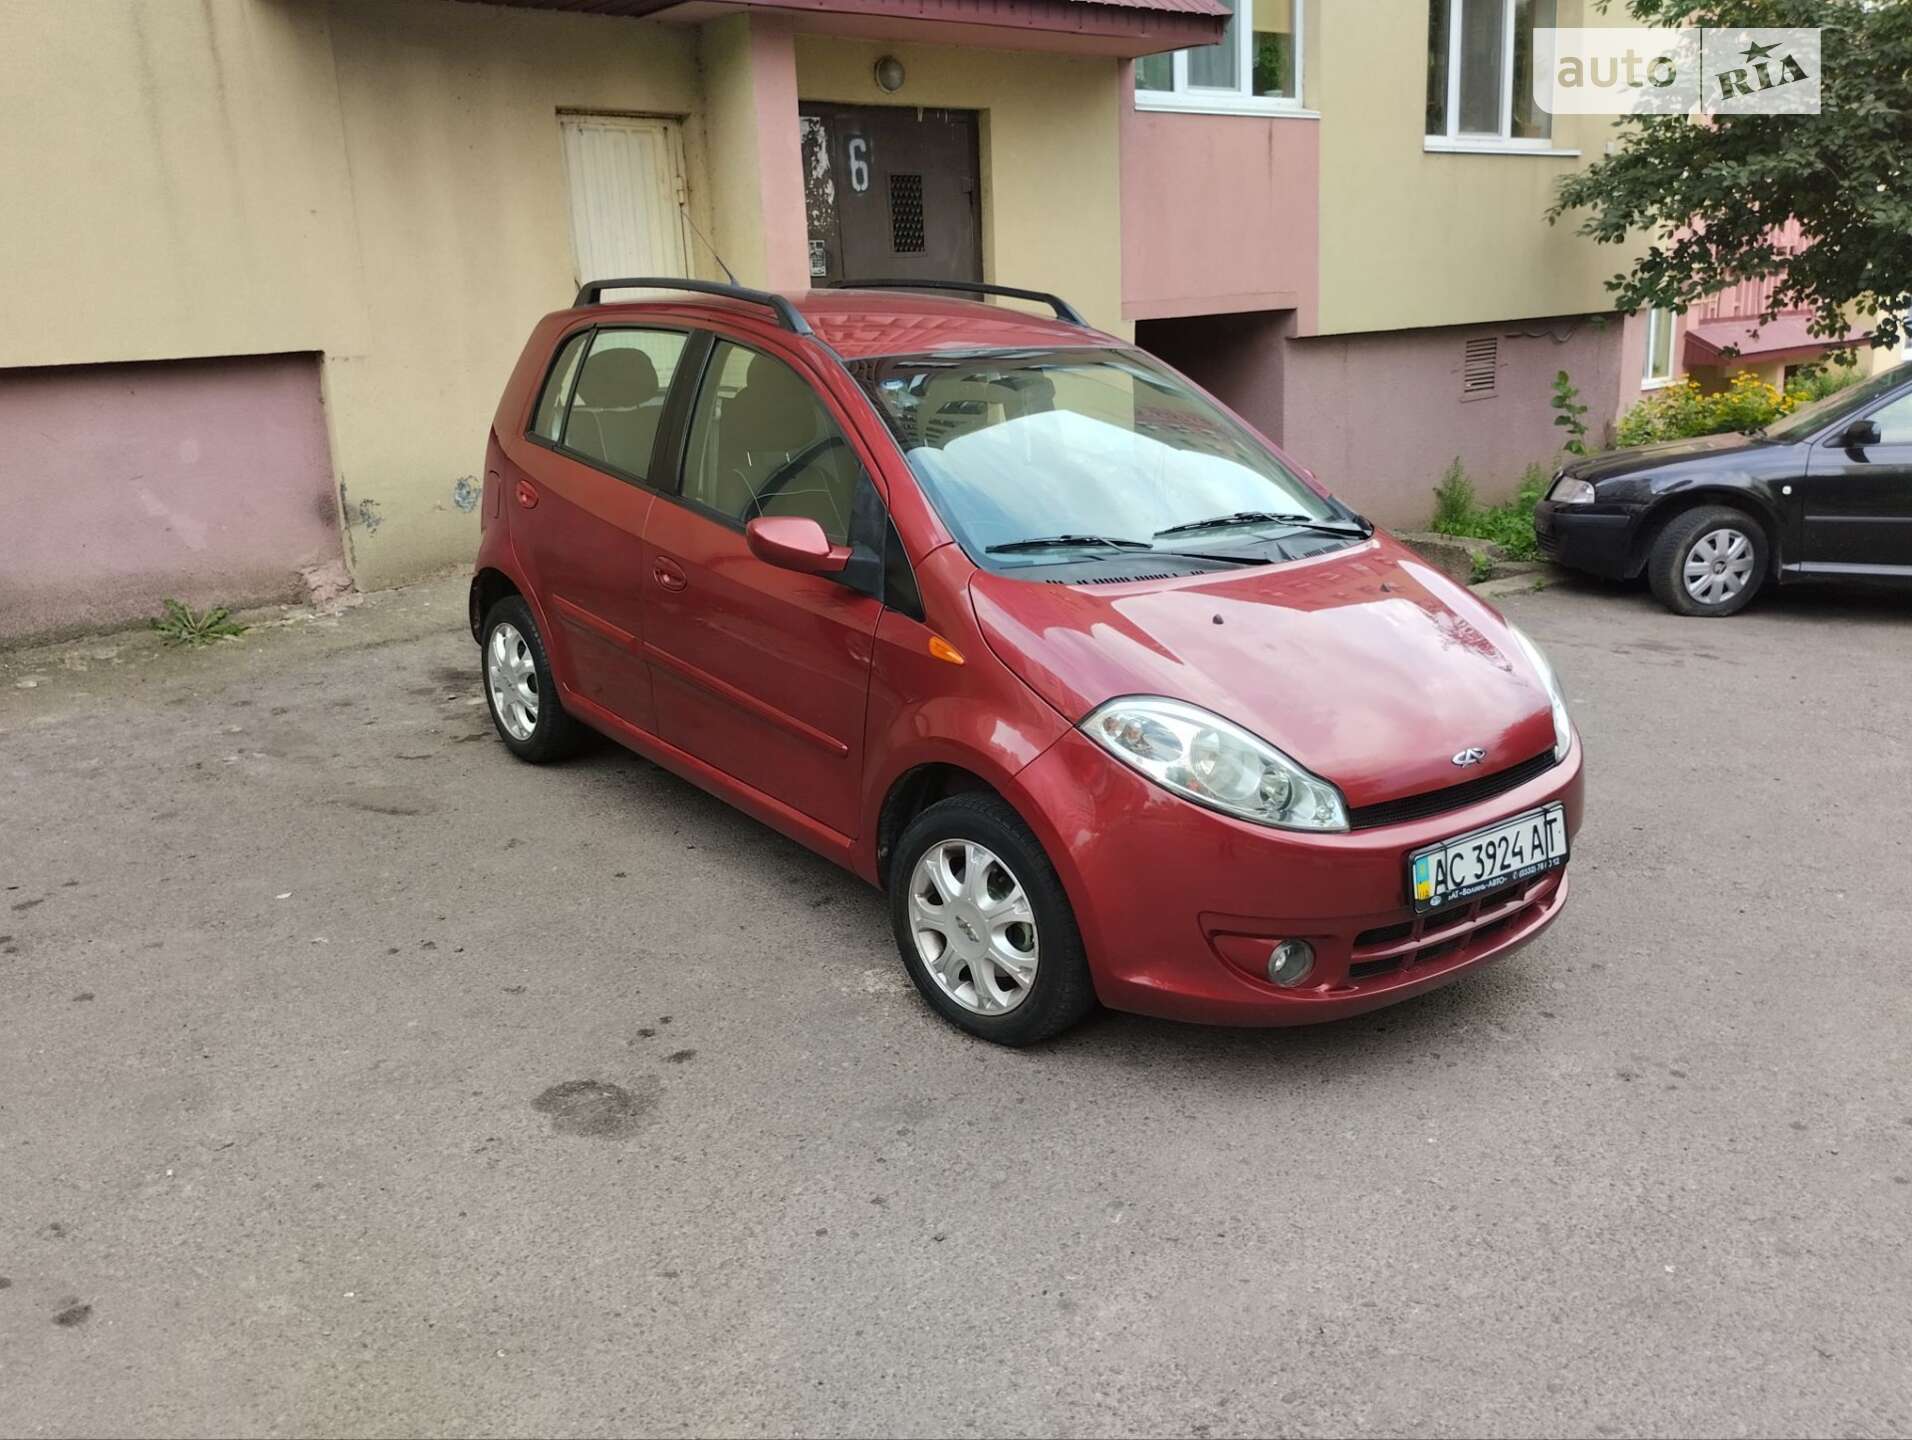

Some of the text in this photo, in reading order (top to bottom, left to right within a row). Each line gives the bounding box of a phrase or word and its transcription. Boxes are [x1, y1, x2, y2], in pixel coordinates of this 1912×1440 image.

[849, 138, 869, 191] 6
[1434, 817, 1558, 896] AC 3924 AT
